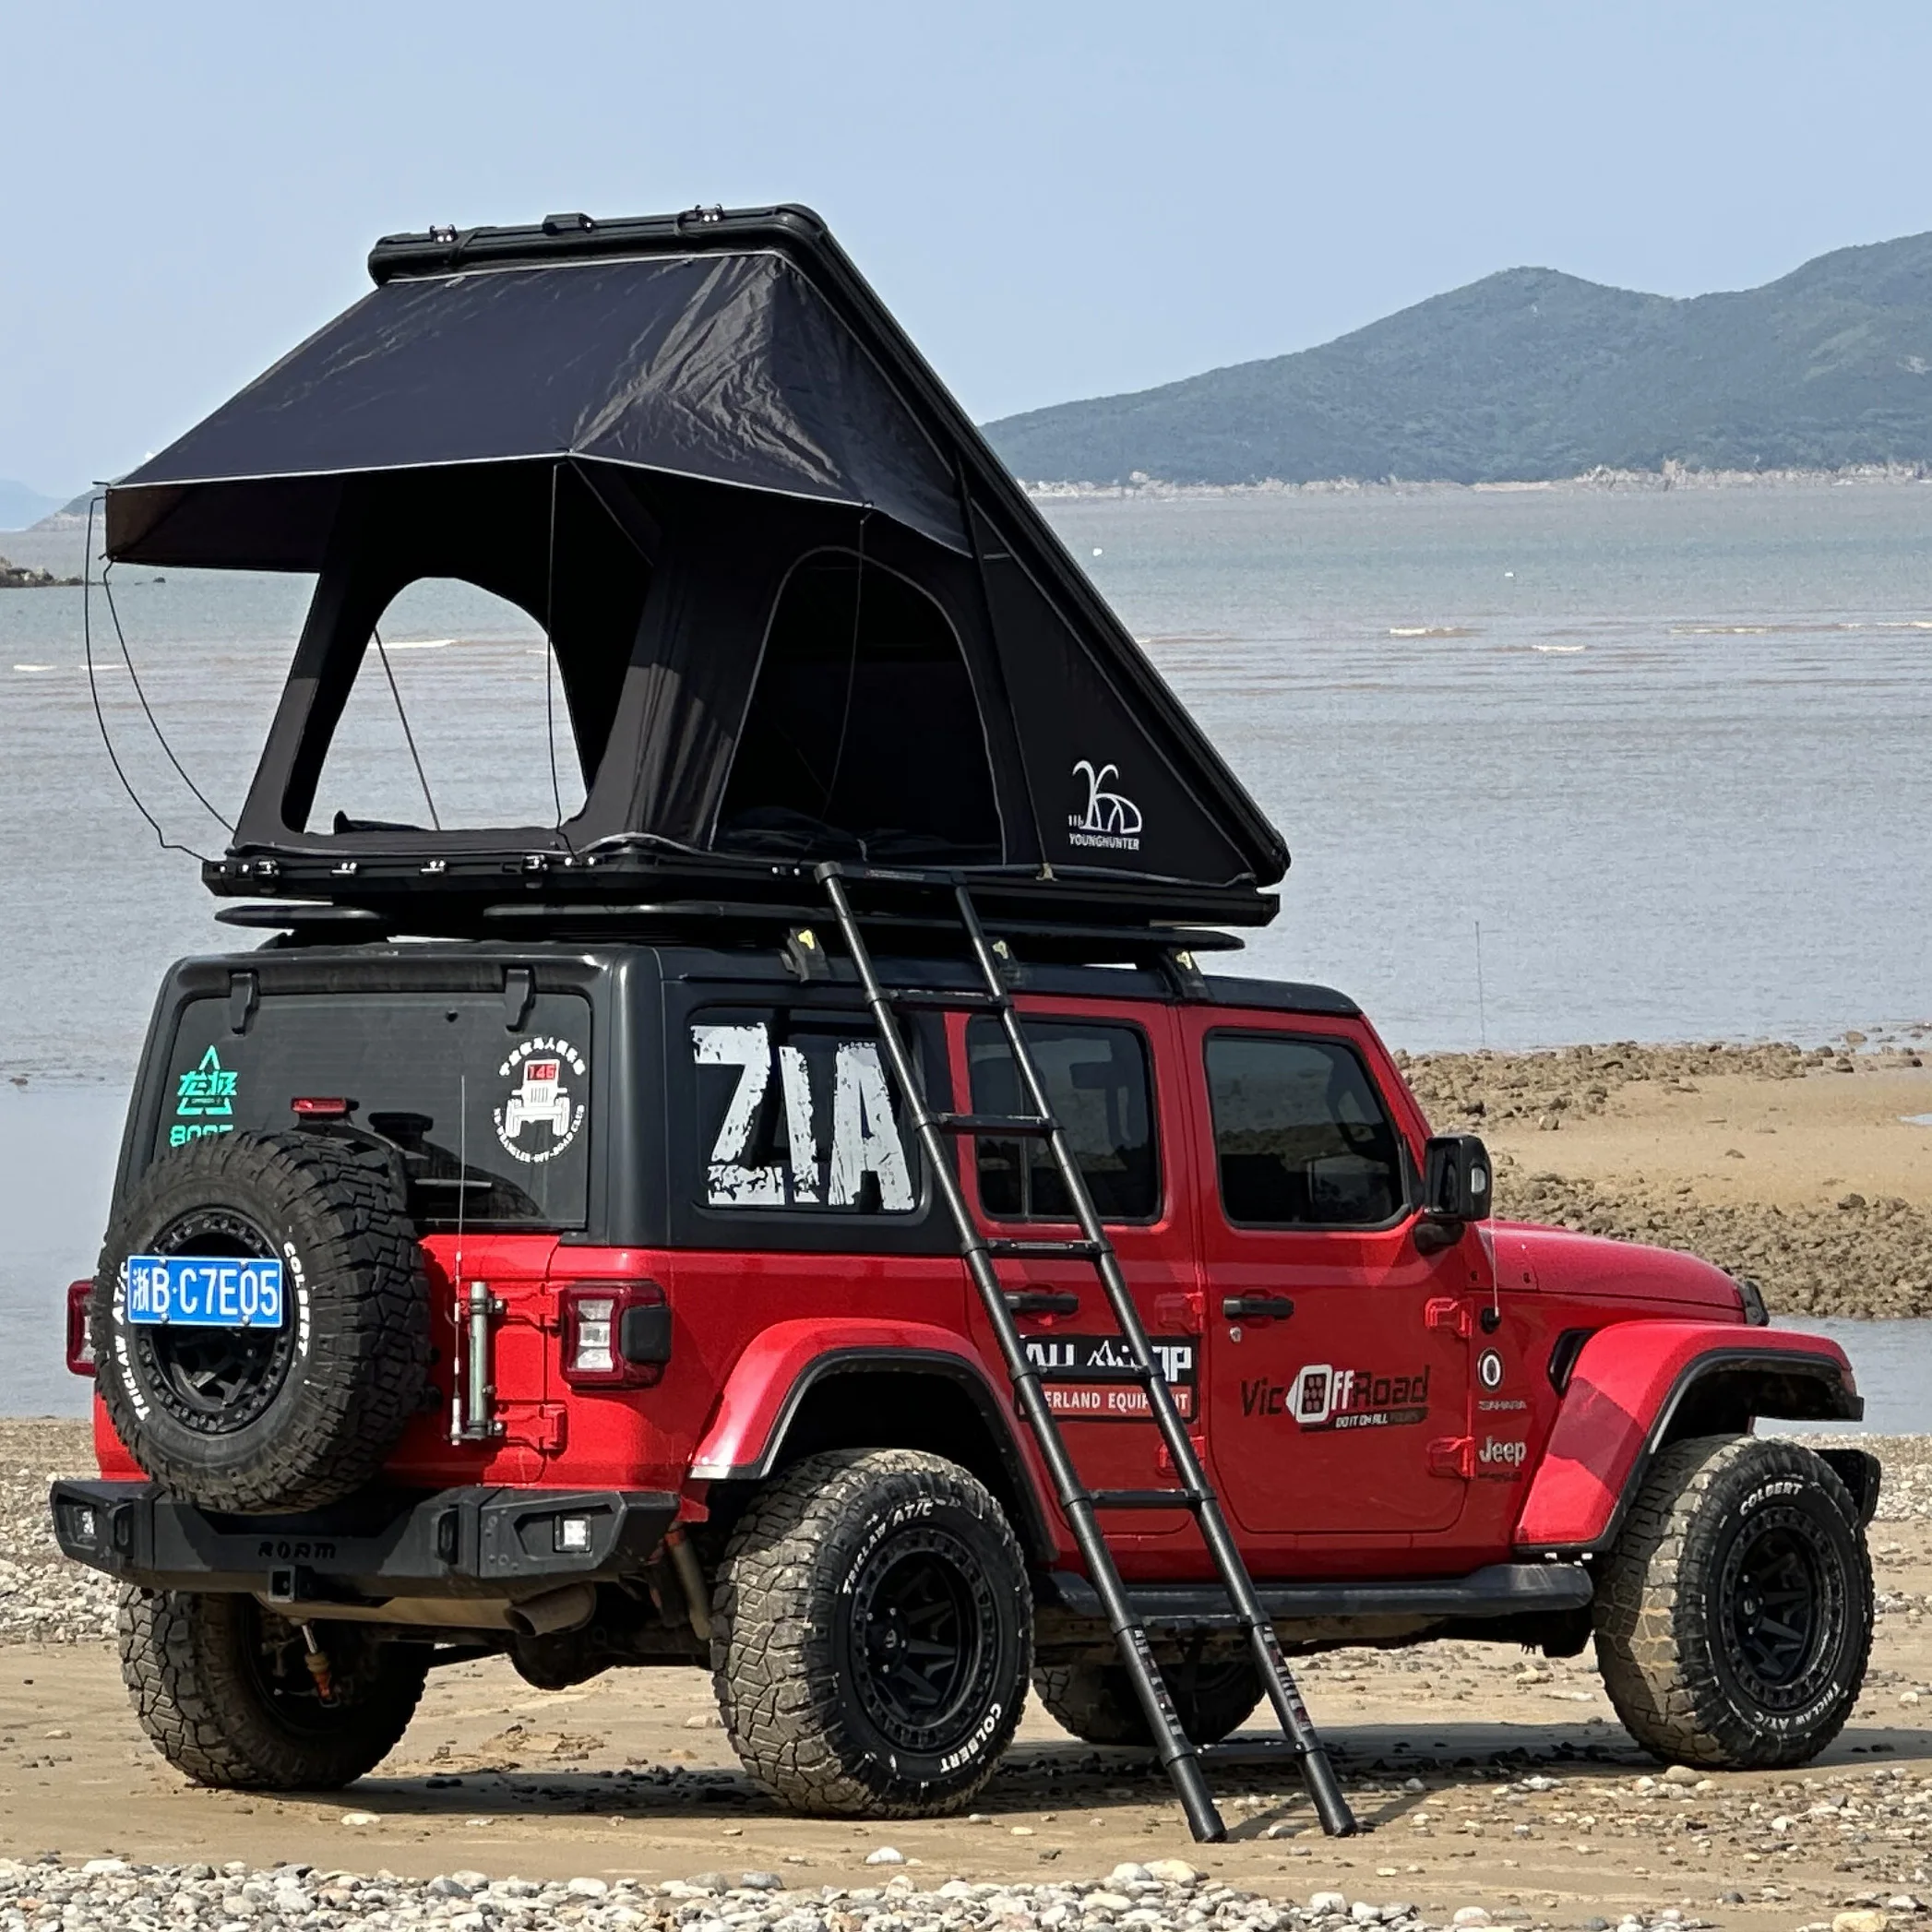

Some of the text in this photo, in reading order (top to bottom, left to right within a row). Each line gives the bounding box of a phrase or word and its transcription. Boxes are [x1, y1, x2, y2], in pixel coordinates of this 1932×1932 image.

[1068, 832, 1140, 851] YOUNGHUNTER
[282, 1241, 311, 1357] COLBERT
[1478, 1436, 1528, 1467] Jeep
[1739, 1481, 1804, 1517] COLBERT
[939, 1702, 1003, 1774] COLBERT
